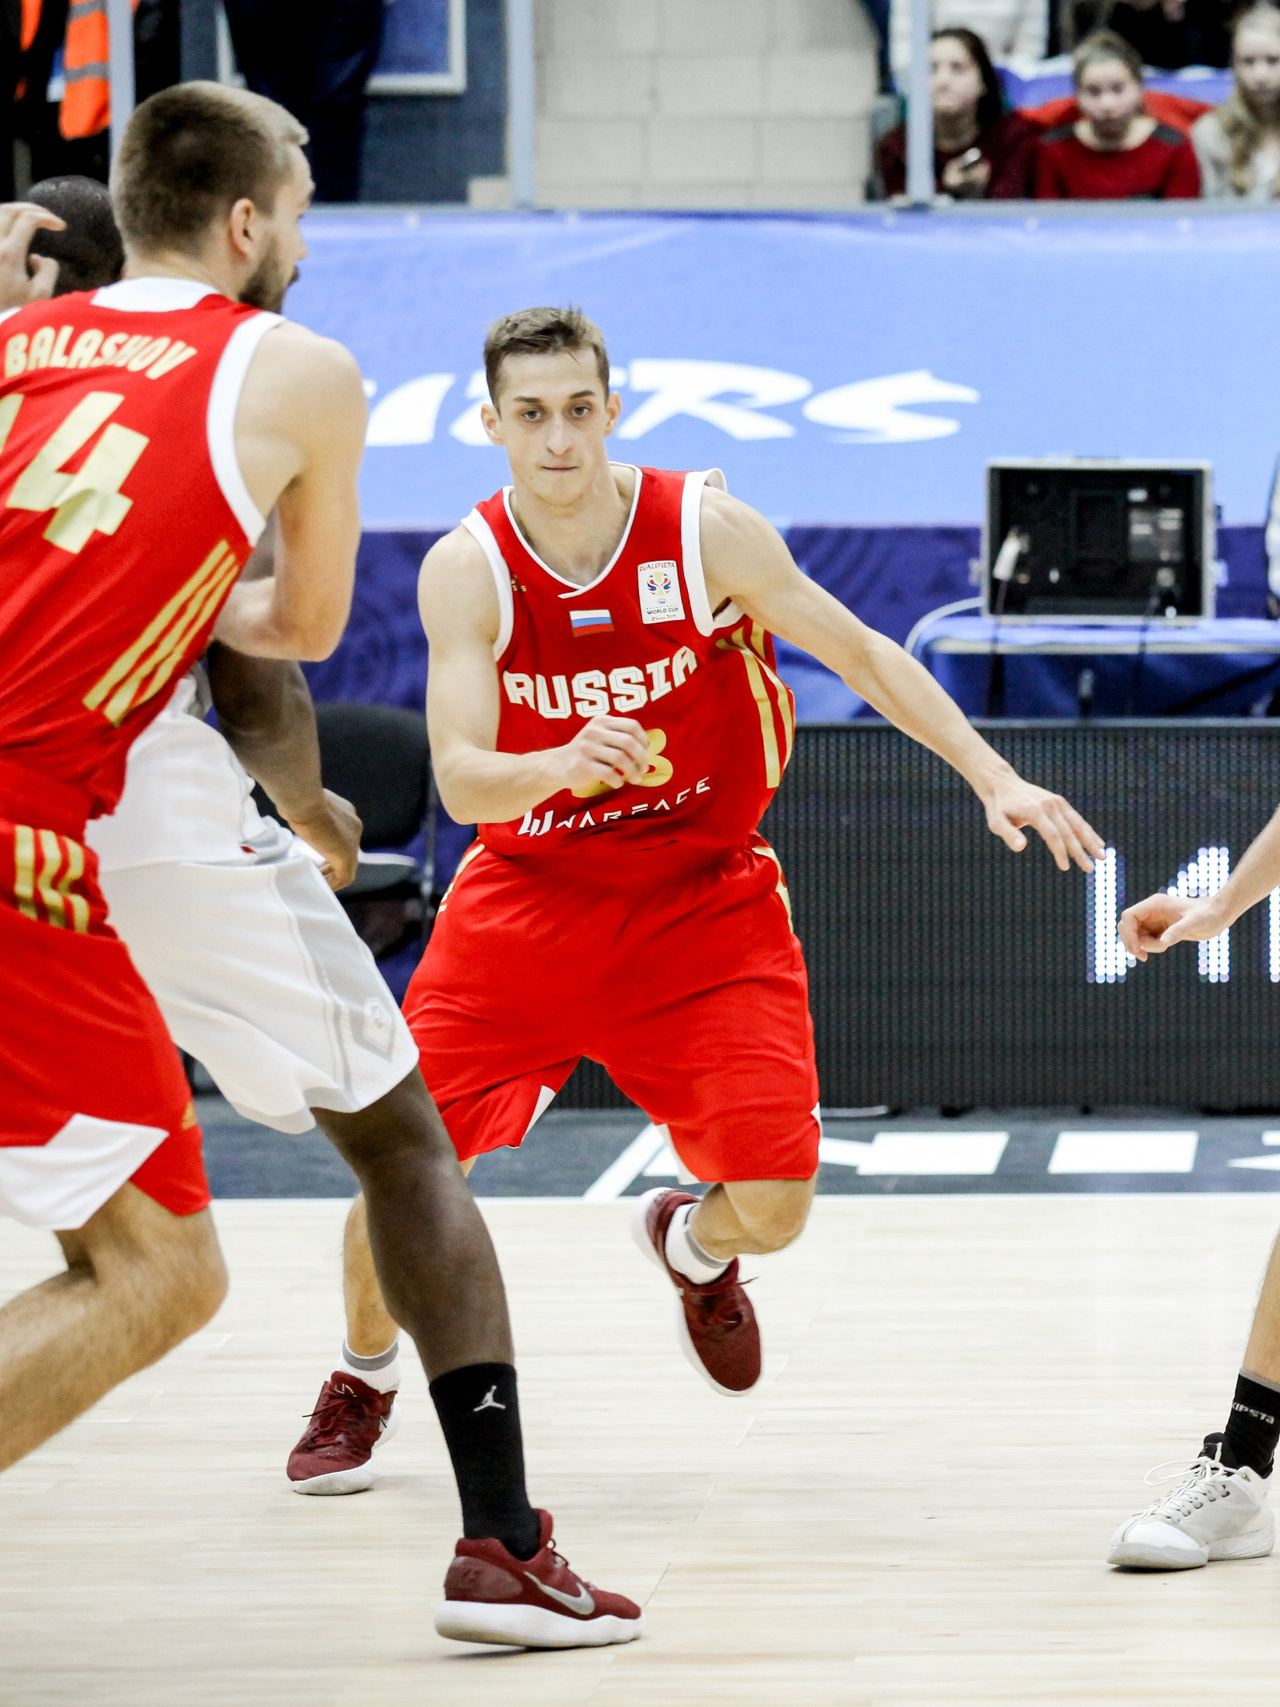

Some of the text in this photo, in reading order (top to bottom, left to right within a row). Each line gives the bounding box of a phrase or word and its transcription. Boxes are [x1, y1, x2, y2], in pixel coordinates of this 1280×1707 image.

[4, 325, 198, 380] BALASHOV
[502, 645, 698, 720] RUSSIA
[555, 776, 711, 830] WARFACE
